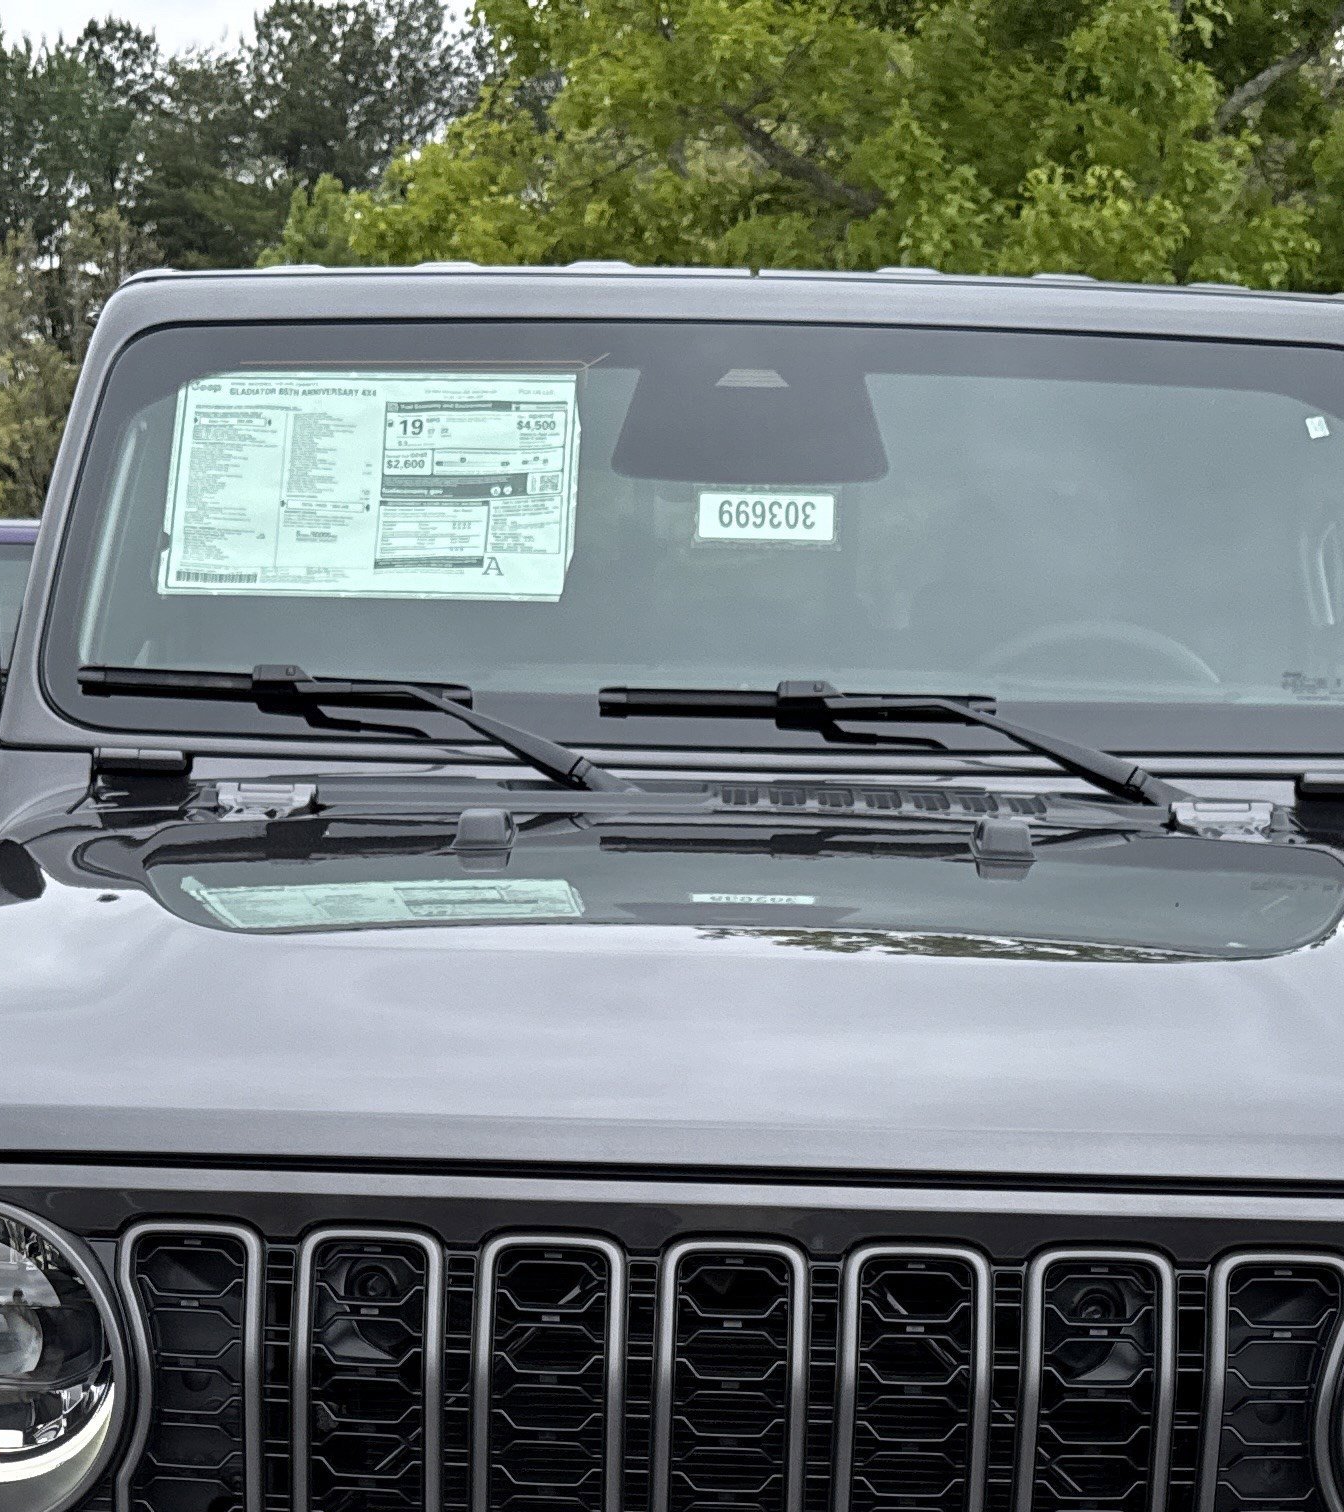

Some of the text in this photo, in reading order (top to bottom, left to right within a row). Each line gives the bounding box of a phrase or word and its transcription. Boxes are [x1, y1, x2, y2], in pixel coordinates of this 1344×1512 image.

[229, 387, 276, 396] GLADIATOR
[301, 388, 359, 398] ANNIVERSARY
[399, 419, 423, 436] 19
[517, 420, 556, 431] $4,500
[386, 459, 425, 470] $2,600
[718, 499, 816, 530] 303699
[482, 556, 504, 576] A
